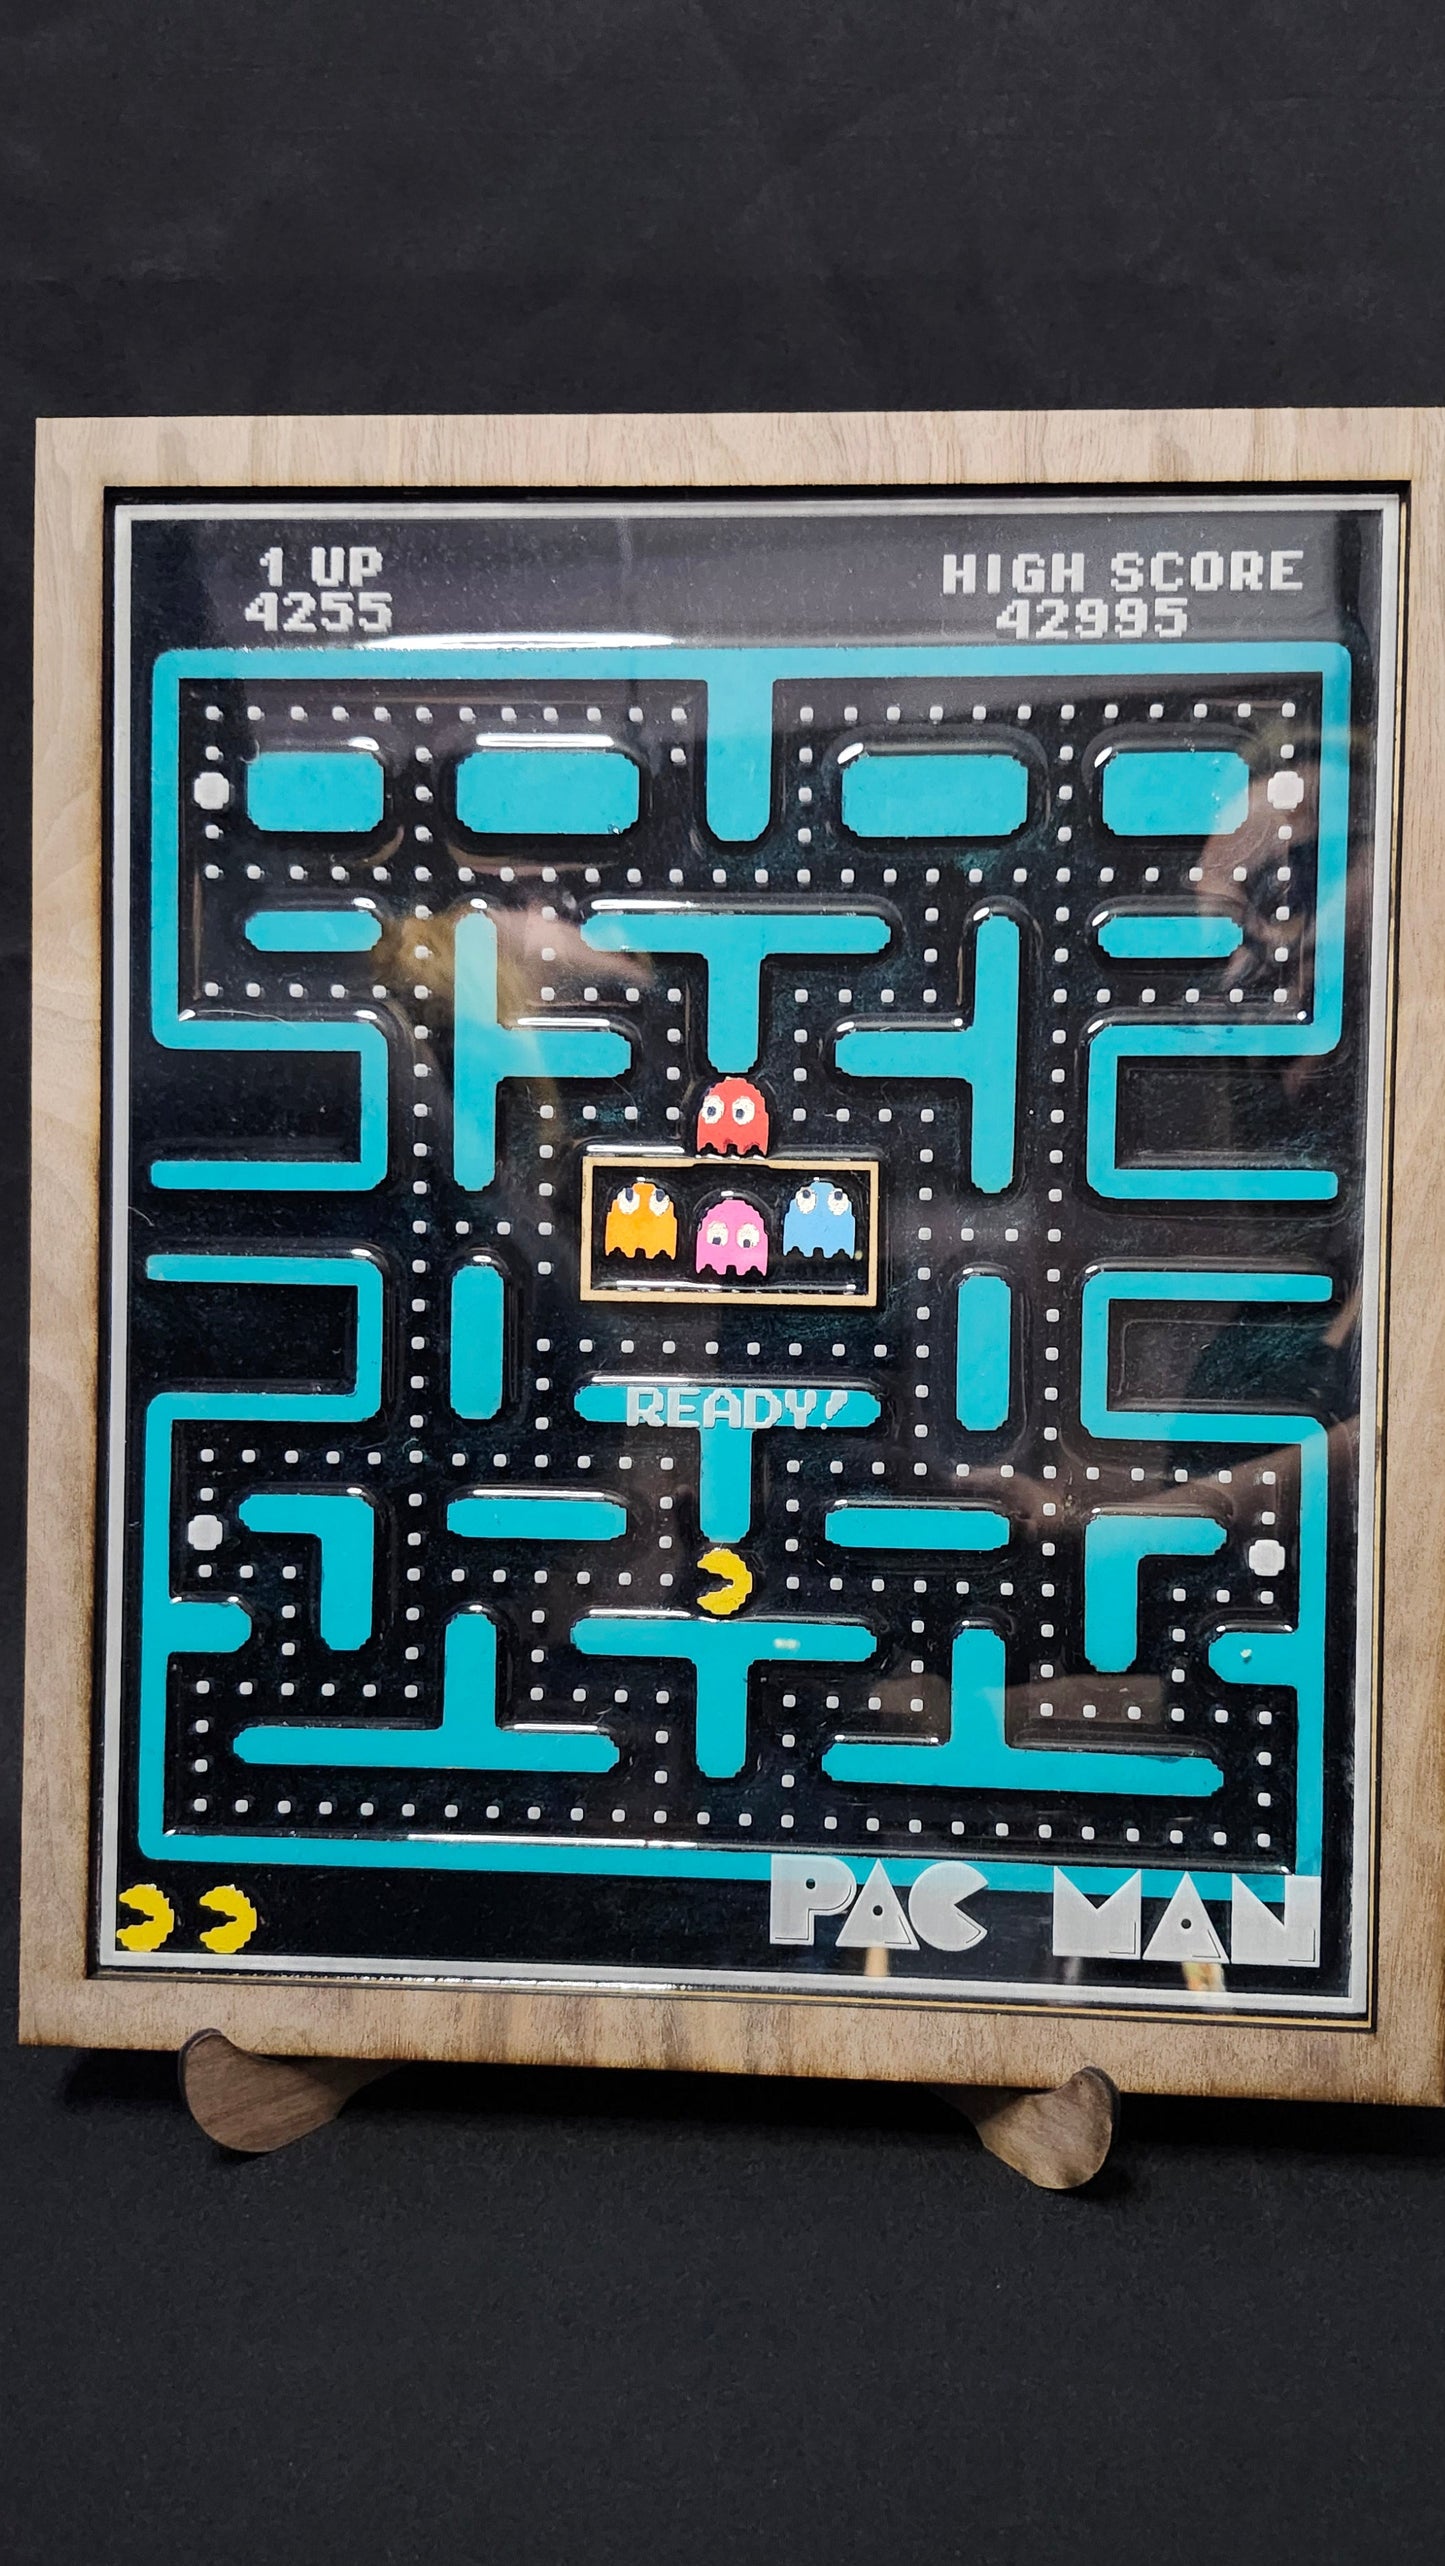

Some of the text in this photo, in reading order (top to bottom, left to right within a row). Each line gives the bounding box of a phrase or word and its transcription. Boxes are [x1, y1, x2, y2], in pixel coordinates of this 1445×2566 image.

[259, 546, 383, 587] 1 UP
[943, 550, 1304, 594] HIGH SCORE
[245, 592, 393, 632] 4255
[996, 597, 1188, 639] 42995
[626, 1386, 848, 1430] READY!
[770, 1854, 1322, 1968] PAC MAN
